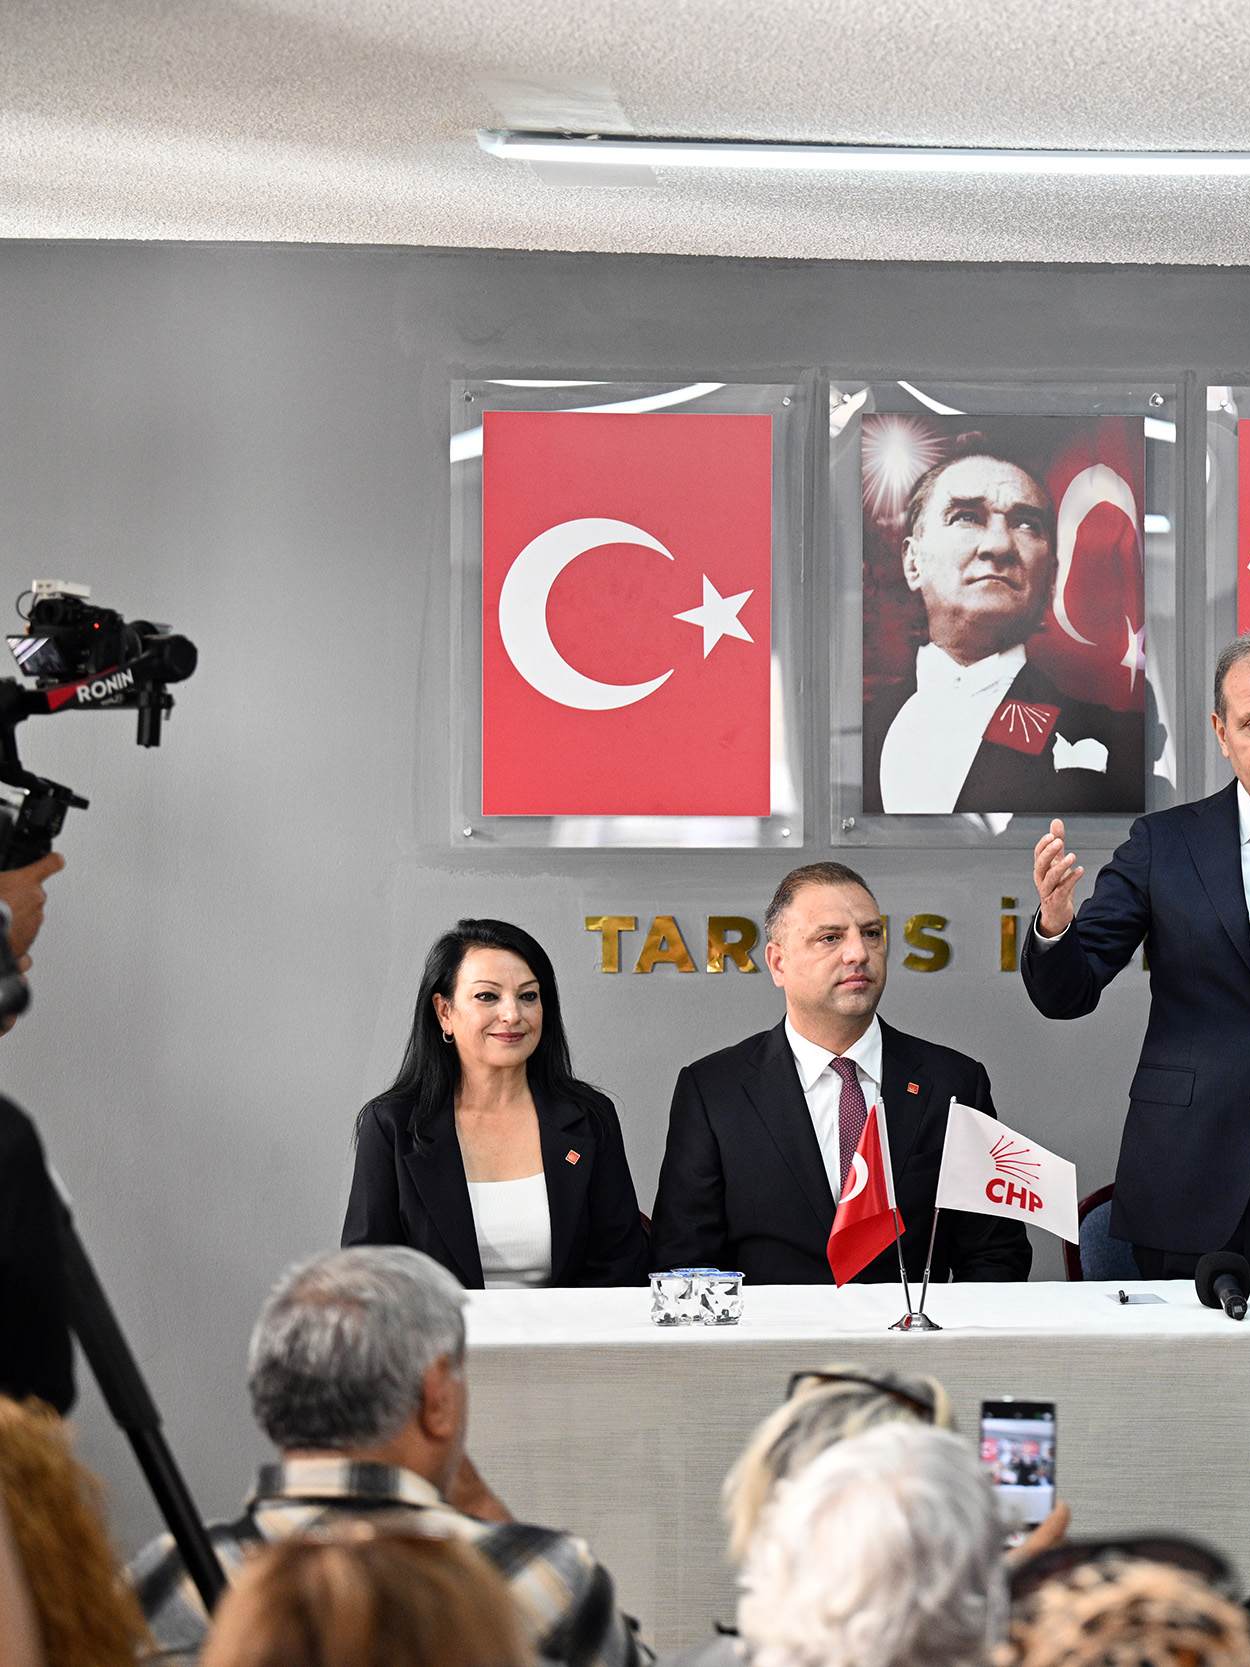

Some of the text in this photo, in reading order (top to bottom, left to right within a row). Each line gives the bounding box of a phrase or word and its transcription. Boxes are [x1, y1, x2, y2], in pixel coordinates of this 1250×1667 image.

[76, 668, 134, 703] RONIN
[584, 913, 951, 974] TARS
[985, 1178, 1043, 1213] CHP
